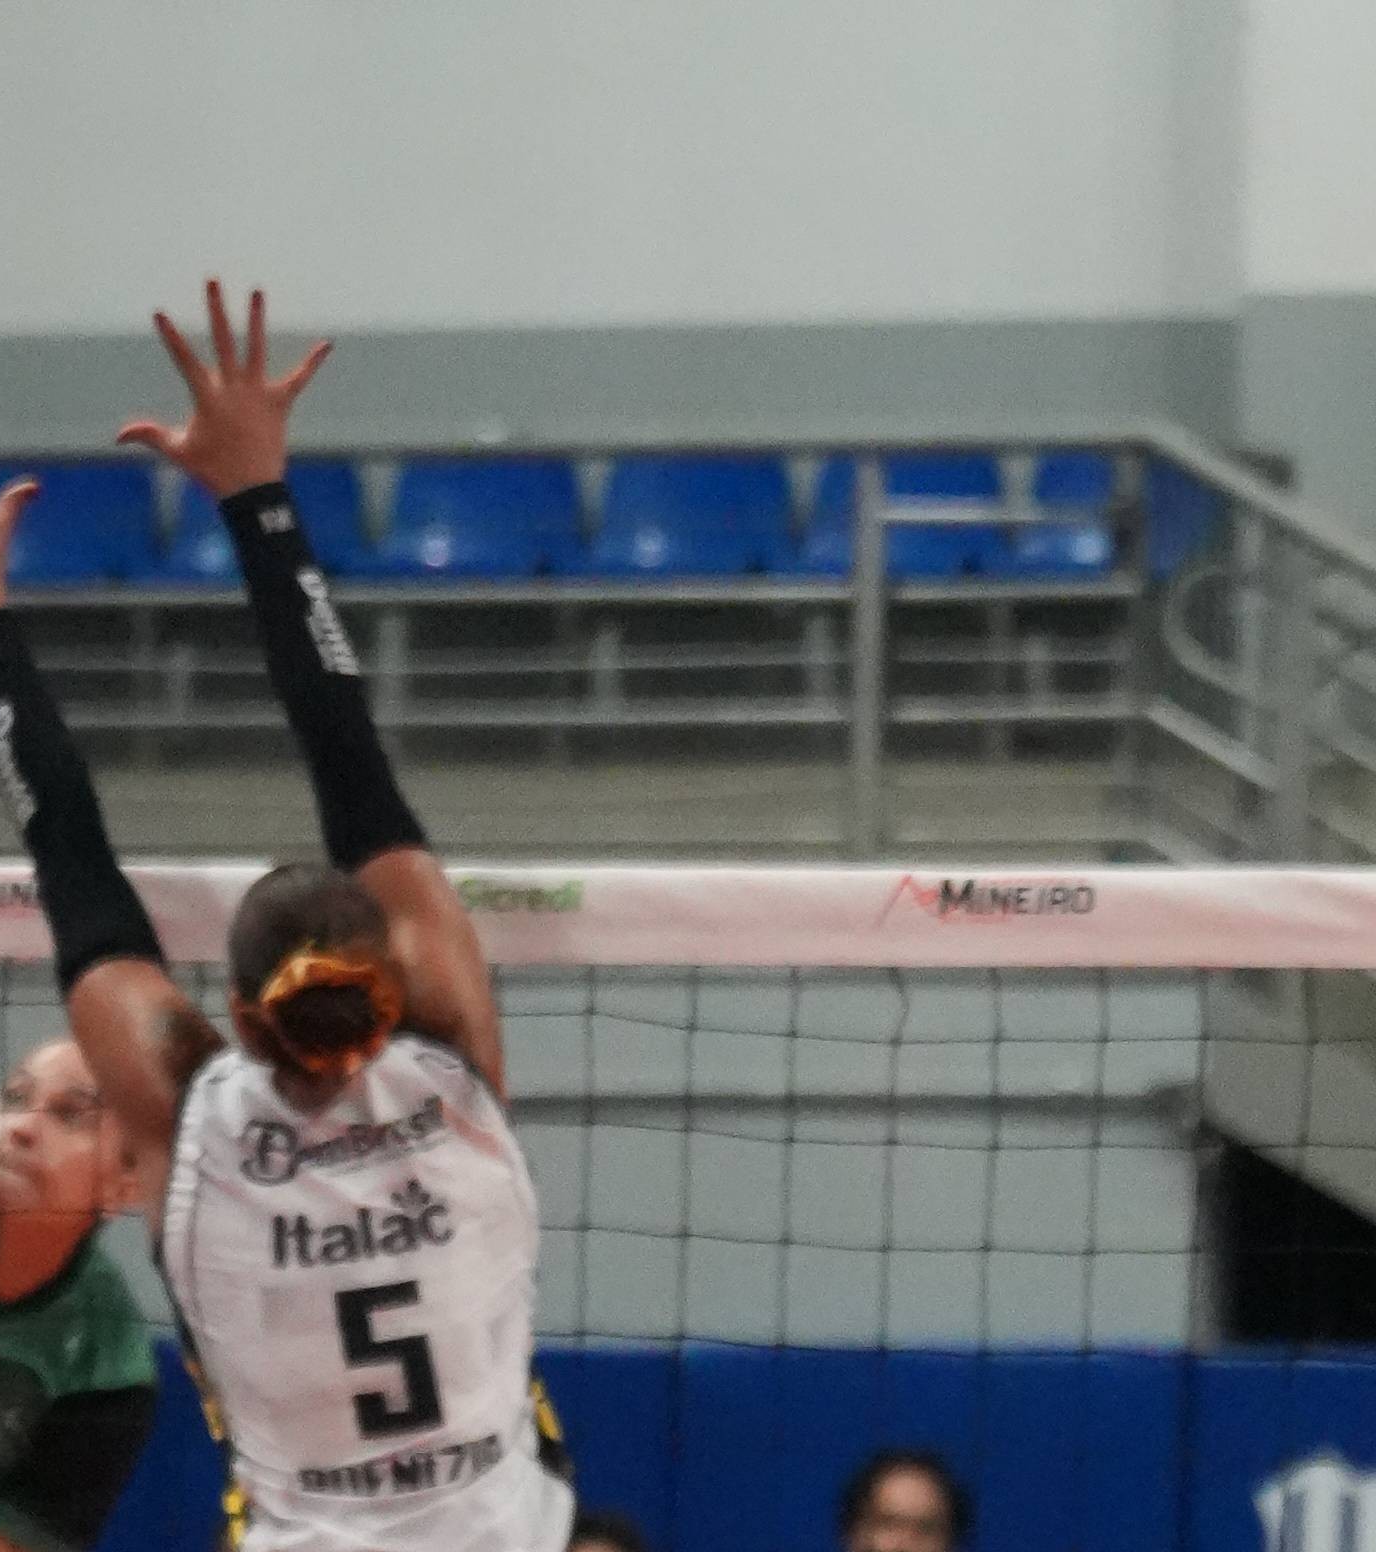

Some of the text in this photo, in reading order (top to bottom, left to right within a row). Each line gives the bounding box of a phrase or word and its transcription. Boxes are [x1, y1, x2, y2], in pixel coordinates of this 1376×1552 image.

[939, 879, 1096, 915] MINEIRO
[270, 1179, 456, 1269] Italac
[335, 1280, 445, 1440] 5
